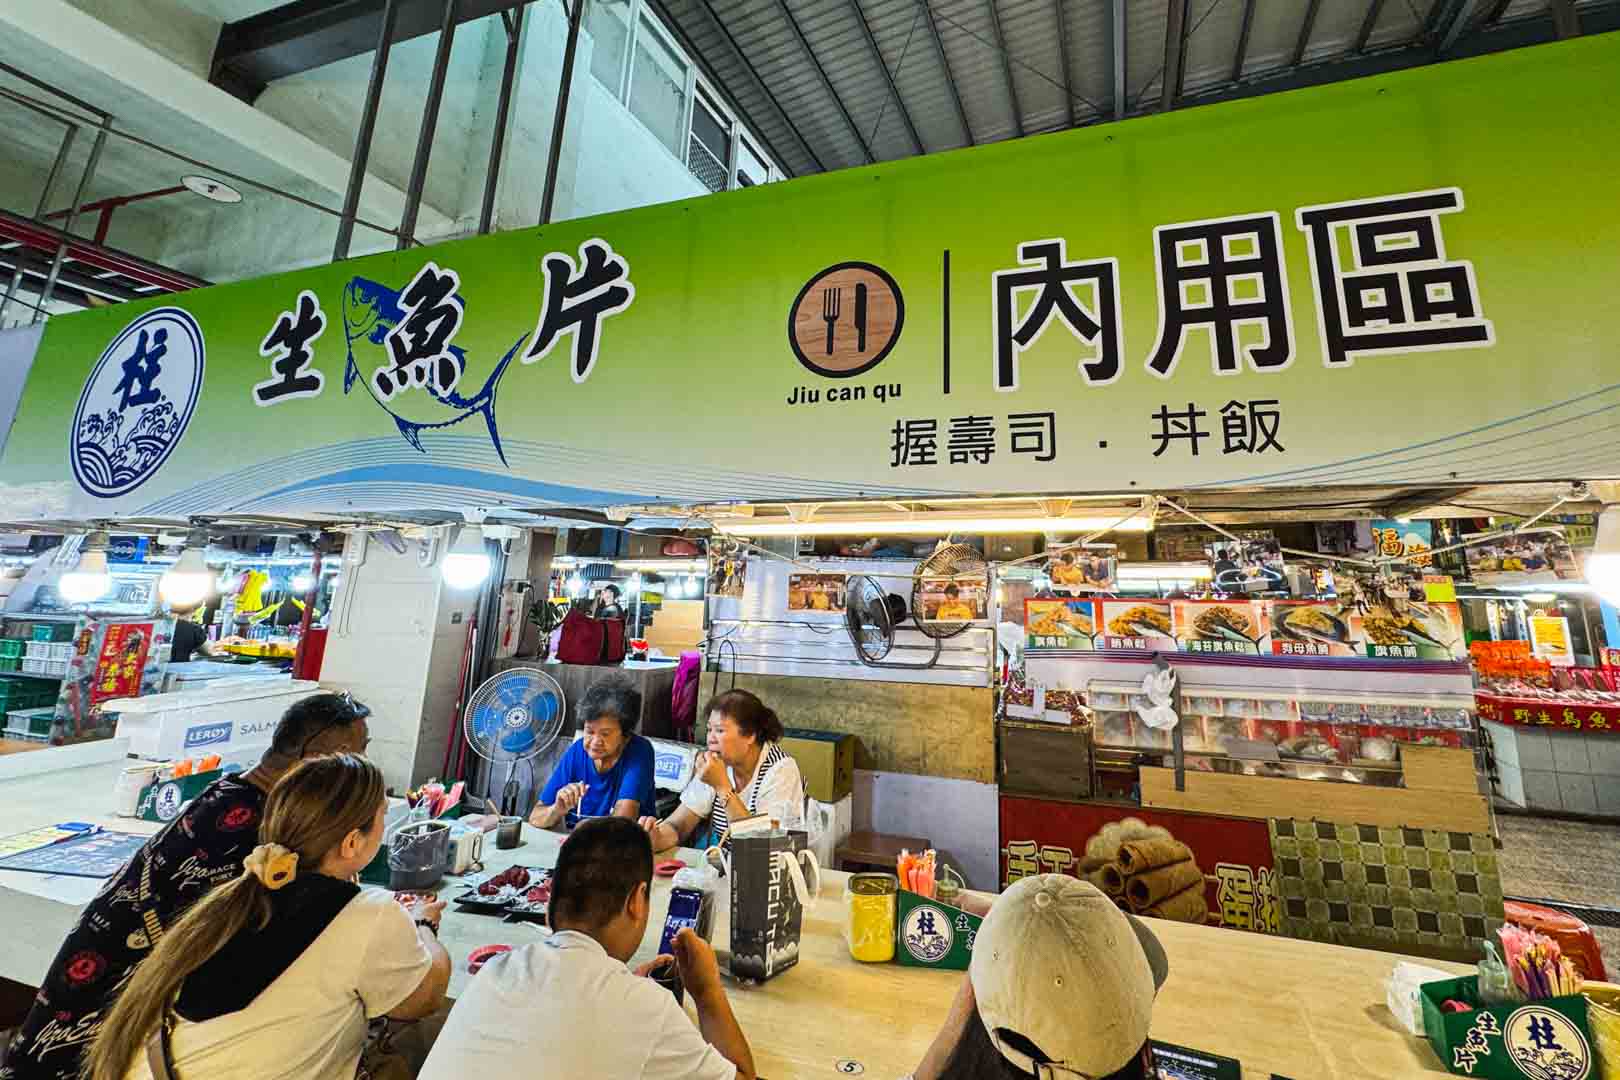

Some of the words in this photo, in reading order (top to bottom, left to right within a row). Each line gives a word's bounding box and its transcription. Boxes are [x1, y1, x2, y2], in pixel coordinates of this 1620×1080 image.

[992, 187, 1495, 392] 內用區
[254, 238, 634, 406] 生魚片
[116, 327, 168, 411] 柱
[787, 386, 820, 405] Jiu
[826, 385, 866, 402] can
[873, 383, 902, 403] qu
[891, 411, 1056, 467] 握壽司
[1151, 400, 1286, 457] 丼飯
[916, 910, 937, 935] 柱
[1454, 1011, 1502, 1073] 生魚片
[1526, 1014, 1563, 1050] 柱
[843, 1062, 857, 1073] 5
